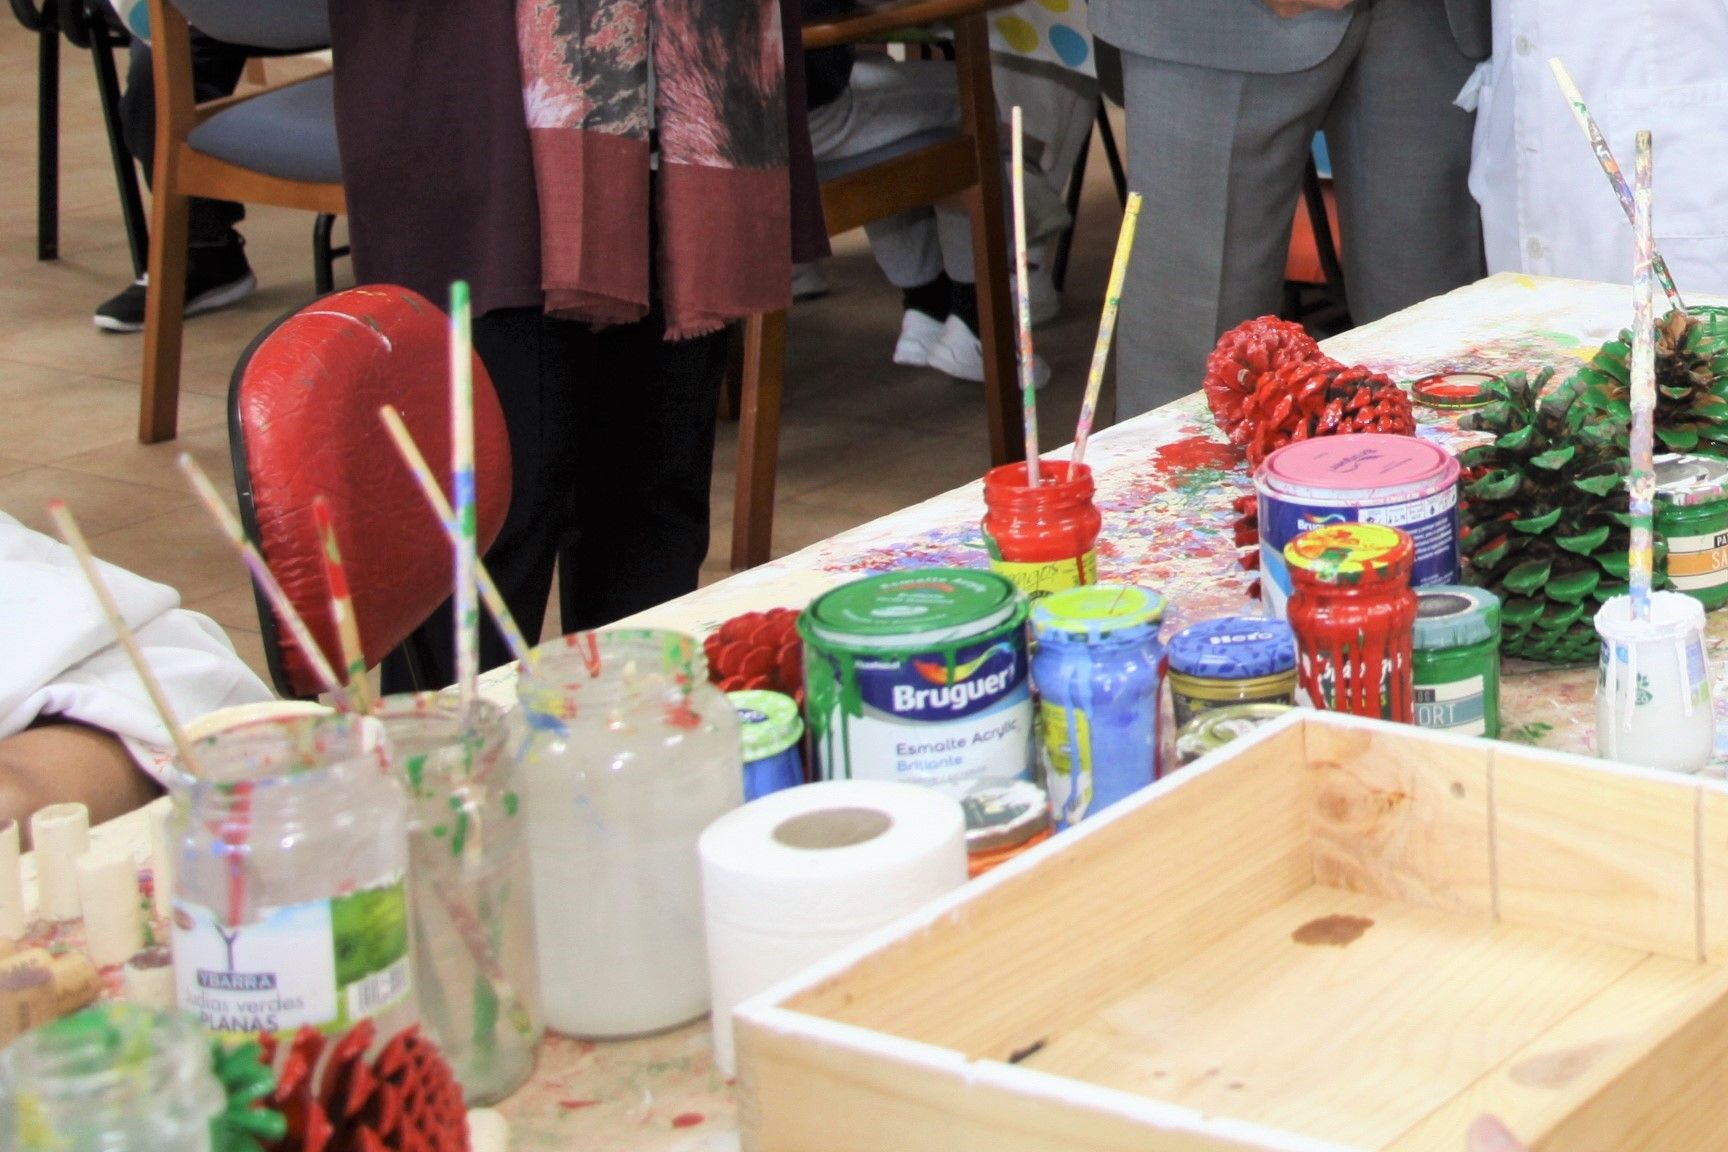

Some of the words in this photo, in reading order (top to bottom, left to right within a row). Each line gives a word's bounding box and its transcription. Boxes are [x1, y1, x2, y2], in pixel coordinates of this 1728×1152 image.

[1209, 631, 1273, 645] Hero
[892, 670, 1009, 711] Bruguer
[1418, 704, 1456, 726] ORT
[896, 735, 967, 756] Esmalte
[896, 754, 964, 773] Brillante
[200, 972, 273, 990] YBARRA
[236, 991, 305, 1014] verdes
[200, 1011, 279, 1033] PLANAS
